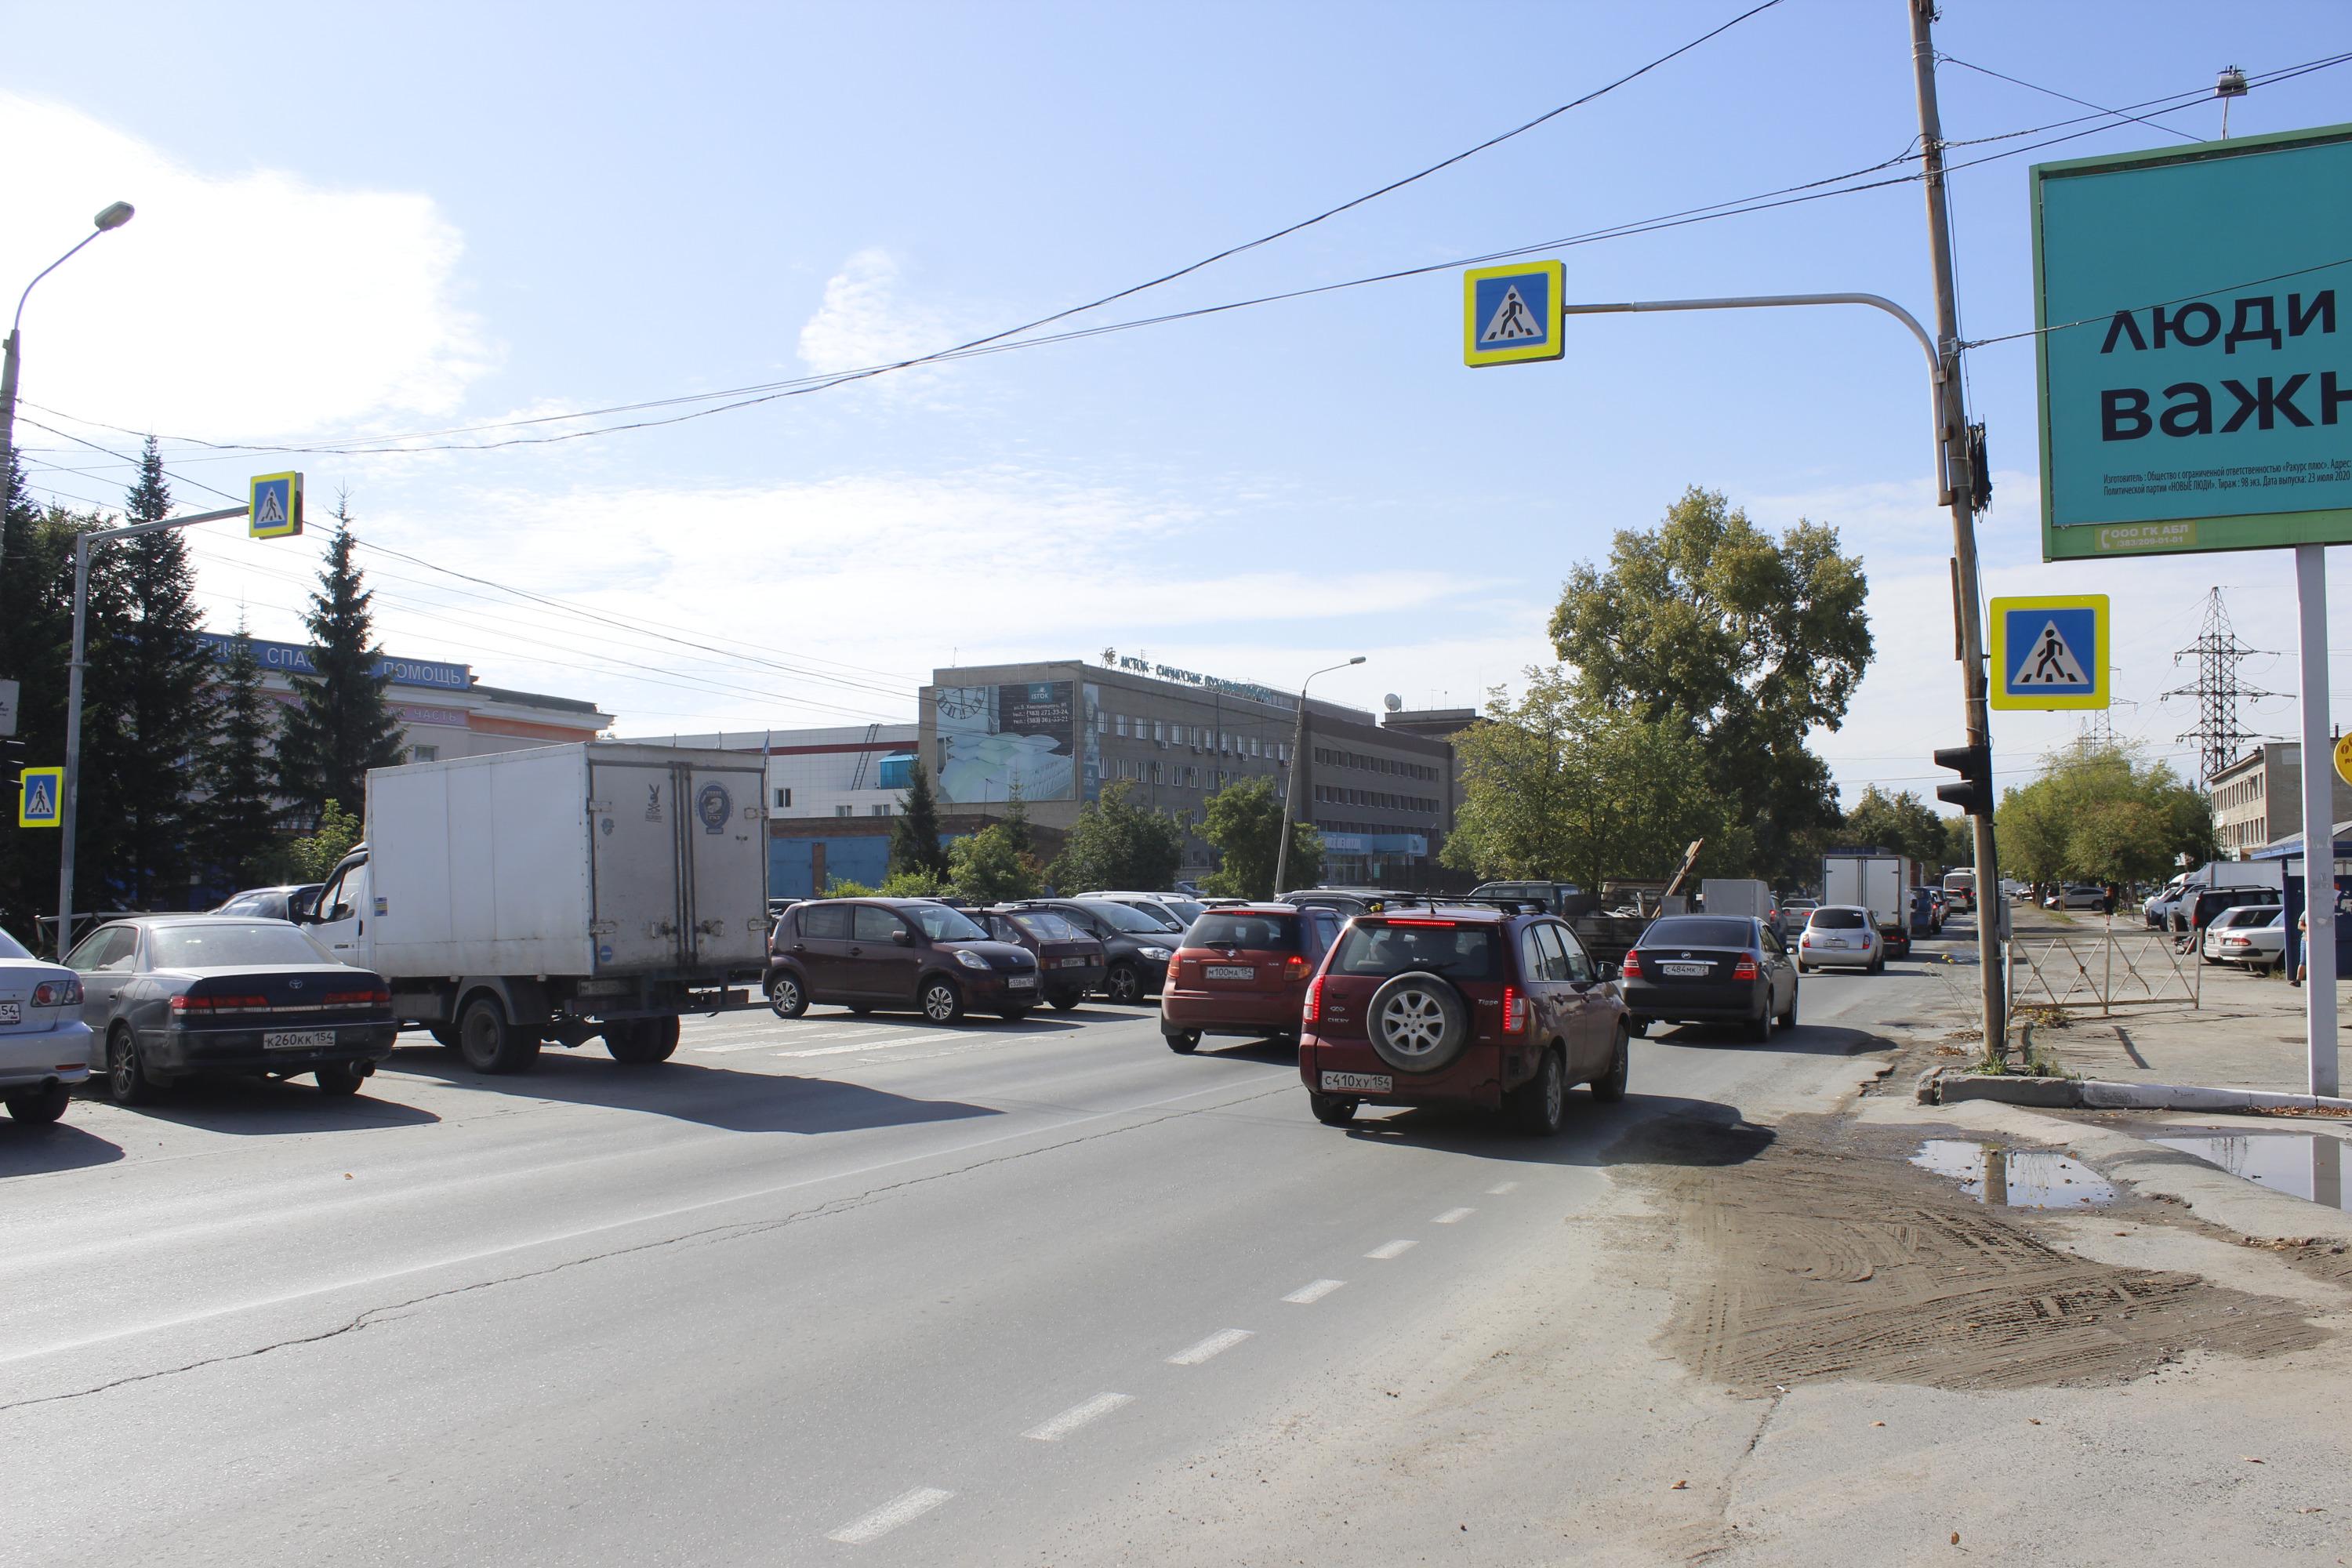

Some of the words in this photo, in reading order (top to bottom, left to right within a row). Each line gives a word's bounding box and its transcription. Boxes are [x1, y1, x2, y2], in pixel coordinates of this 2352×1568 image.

[2100, 289, 2336, 354] люди
[2103, 474, 2143, 484] Изготовитель
[2147, 470, 2177, 481] Общество
[2182, 466, 2225, 477] ограниченной
[2227, 464, 2281, 476] ответственностью
[2103, 484, 2145, 495] Политической
[2146, 484, 2167, 495] партии
[2168, 480, 2193, 492] «НОВЫЕ
[2218, 478, 2236, 491] Тираж
[2241, 477, 2249, 488] 98
[2263, 476, 2278, 488] Дата
[2278, 474, 2307, 486] выпуска:
[2307, 473, 2315, 483] 23
[2317, 474, 2334, 482] июля
[2335, 470, 2350, 481] 2020
[2111, 528, 2139, 539] ООО
[2142, 526, 2158, 536] ГК
[2161, 524, 2189, 534] АБЛ
[383, 662, 462, 685] ПОМОЩЬ
[414, 708, 459, 722] ЧАСТЬ
[0, 1005, 16, 1015] 54
[267, 1034, 312, 1047] К260КК
[314, 1032, 333, 1041] 154
[1325, 1073, 1370, 1087] С410ХУ
[1372, 1076, 1389, 1087] 154
